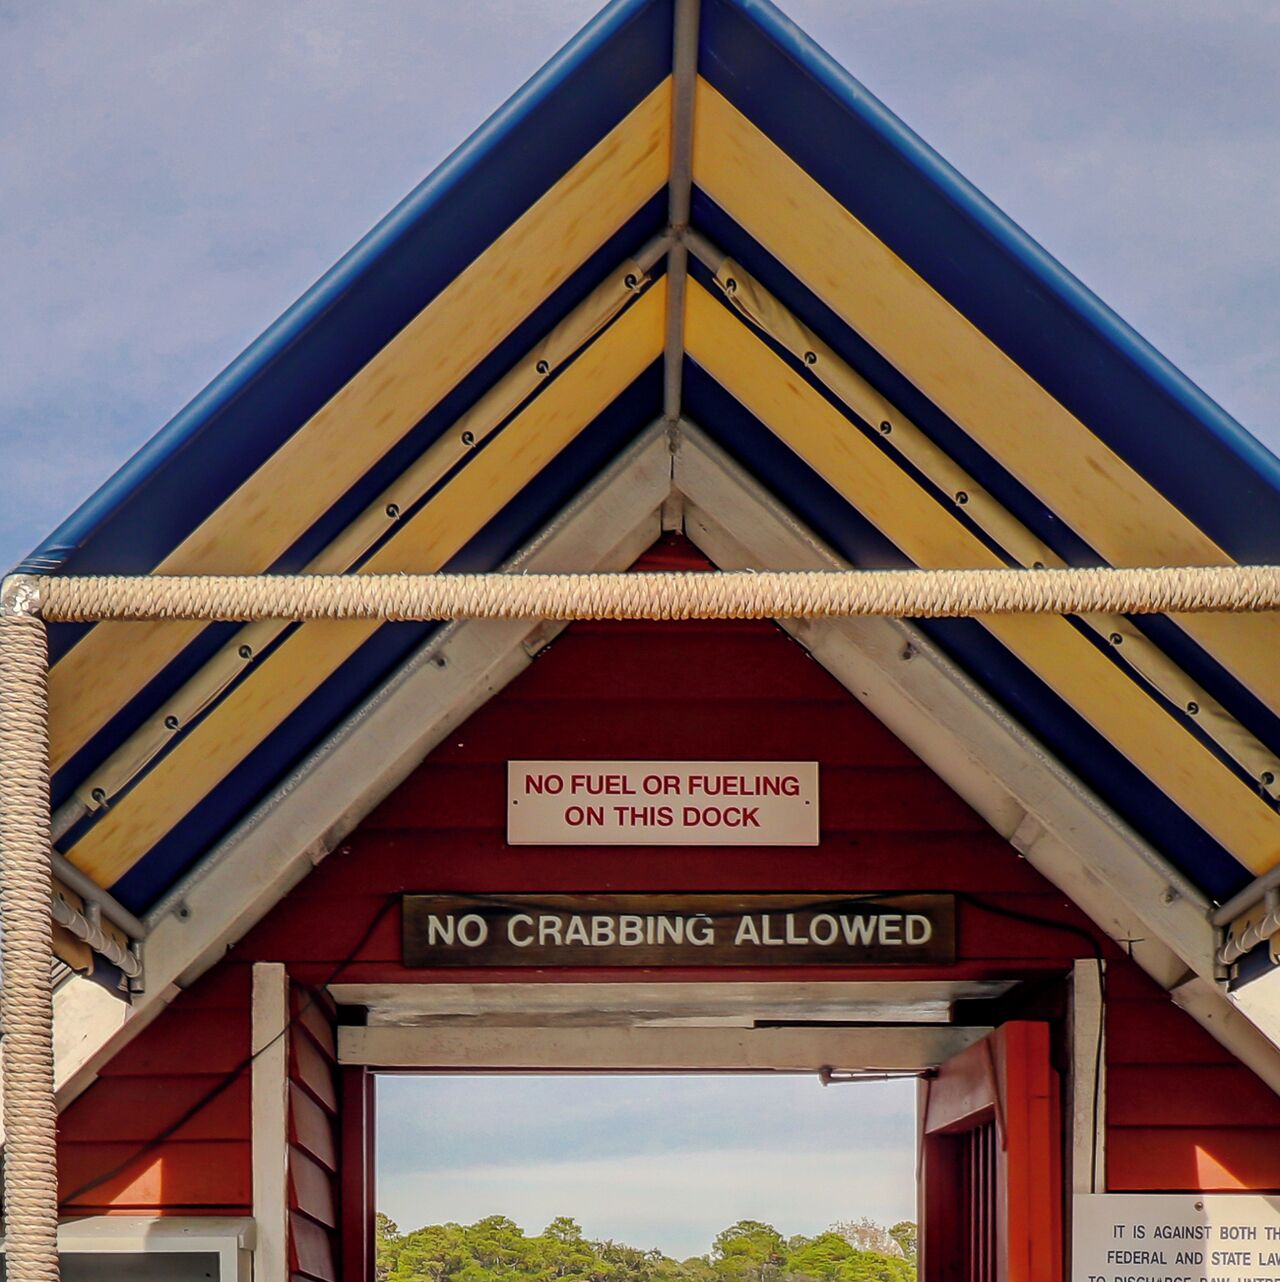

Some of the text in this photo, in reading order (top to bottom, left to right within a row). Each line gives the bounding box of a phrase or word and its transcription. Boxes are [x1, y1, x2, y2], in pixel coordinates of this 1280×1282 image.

[524, 774, 801, 797] NO FUEL OR FUELING
[564, 806, 761, 827] ON THIS DOCK
[427, 914, 933, 948] NO CRABBING ALLOWED
[1113, 1225, 1125, 1239] IT
[1133, 1225, 1146, 1239] IS
[1153, 1225, 1212, 1240] AGAINST
[1220, 1226, 1257, 1240] BOTH
[1107, 1251, 1168, 1265] FEDERAL
[1175, 1252, 1204, 1265] AND
[1211, 1252, 1251, 1266] STATE
